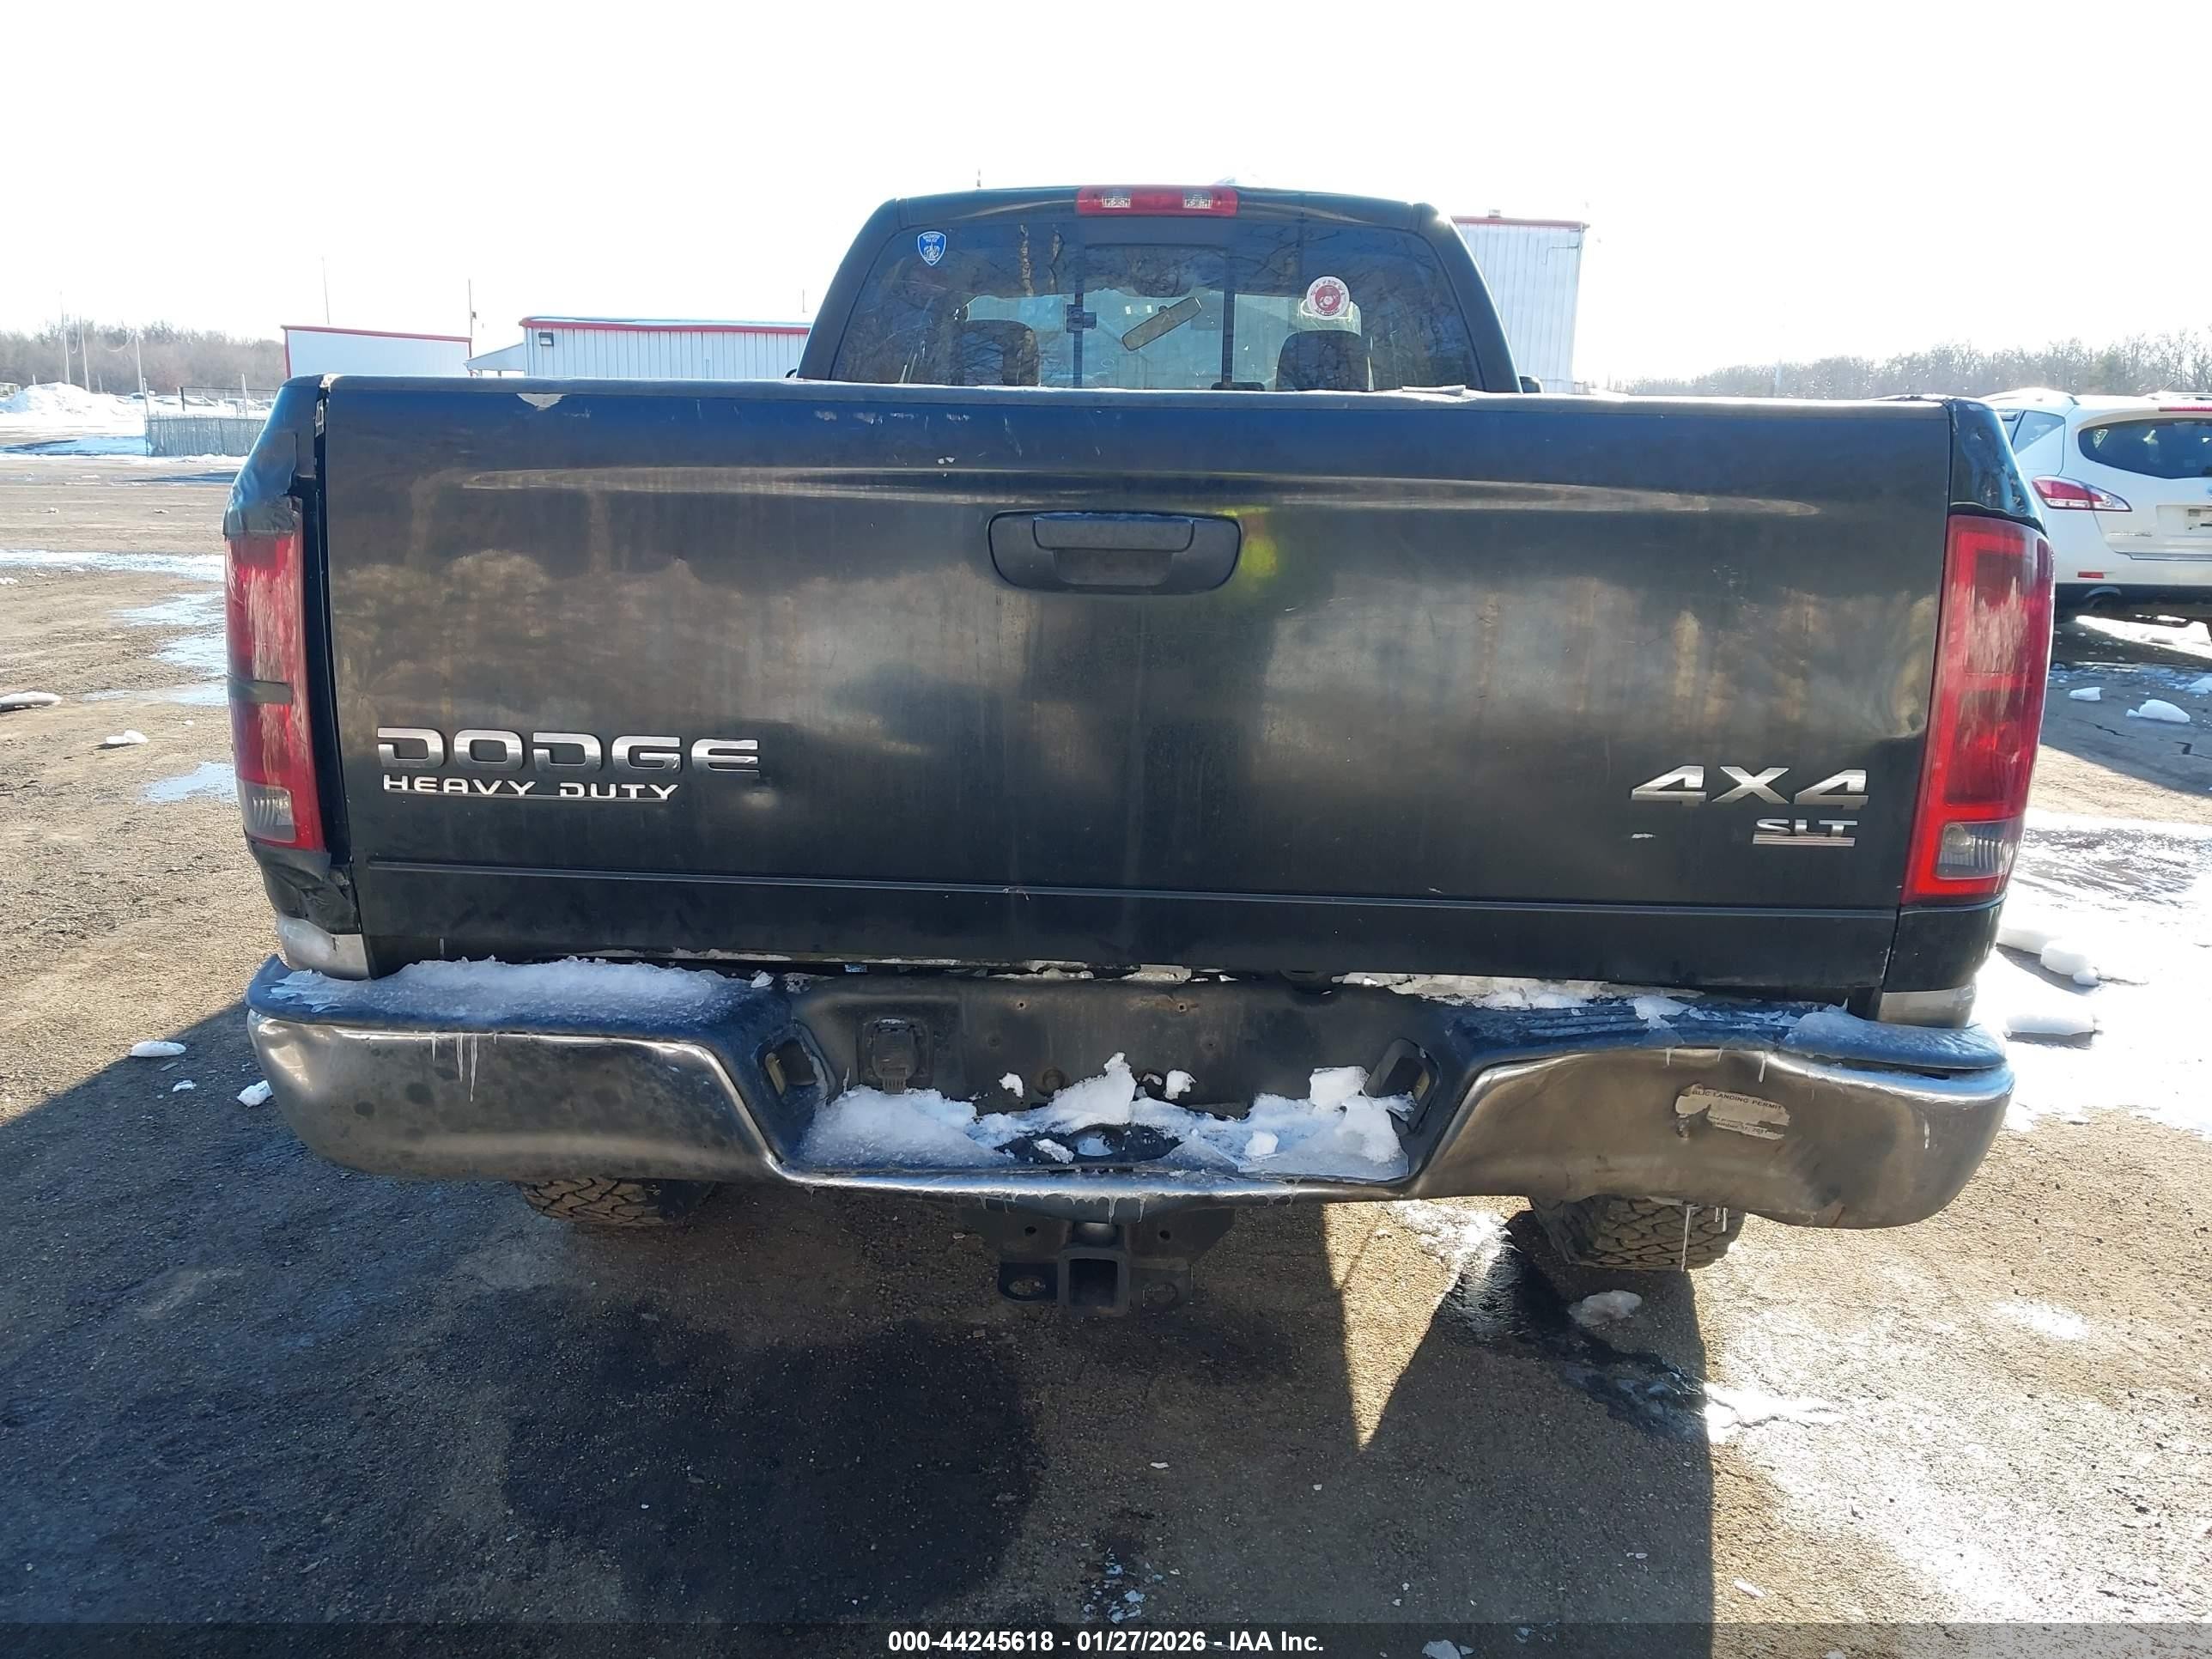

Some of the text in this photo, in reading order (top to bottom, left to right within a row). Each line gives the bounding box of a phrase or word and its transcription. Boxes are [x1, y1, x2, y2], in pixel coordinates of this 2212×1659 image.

[377, 727, 759, 774] DODGE
[383, 775, 679, 800] HEAVY DUTY
[1631, 765, 1869, 810] 4X4
[1756, 819, 1858, 837] SLT
[1712, 1091, 1749, 1103] LANDING
[1752, 1100, 1783, 1109] PERMIT
